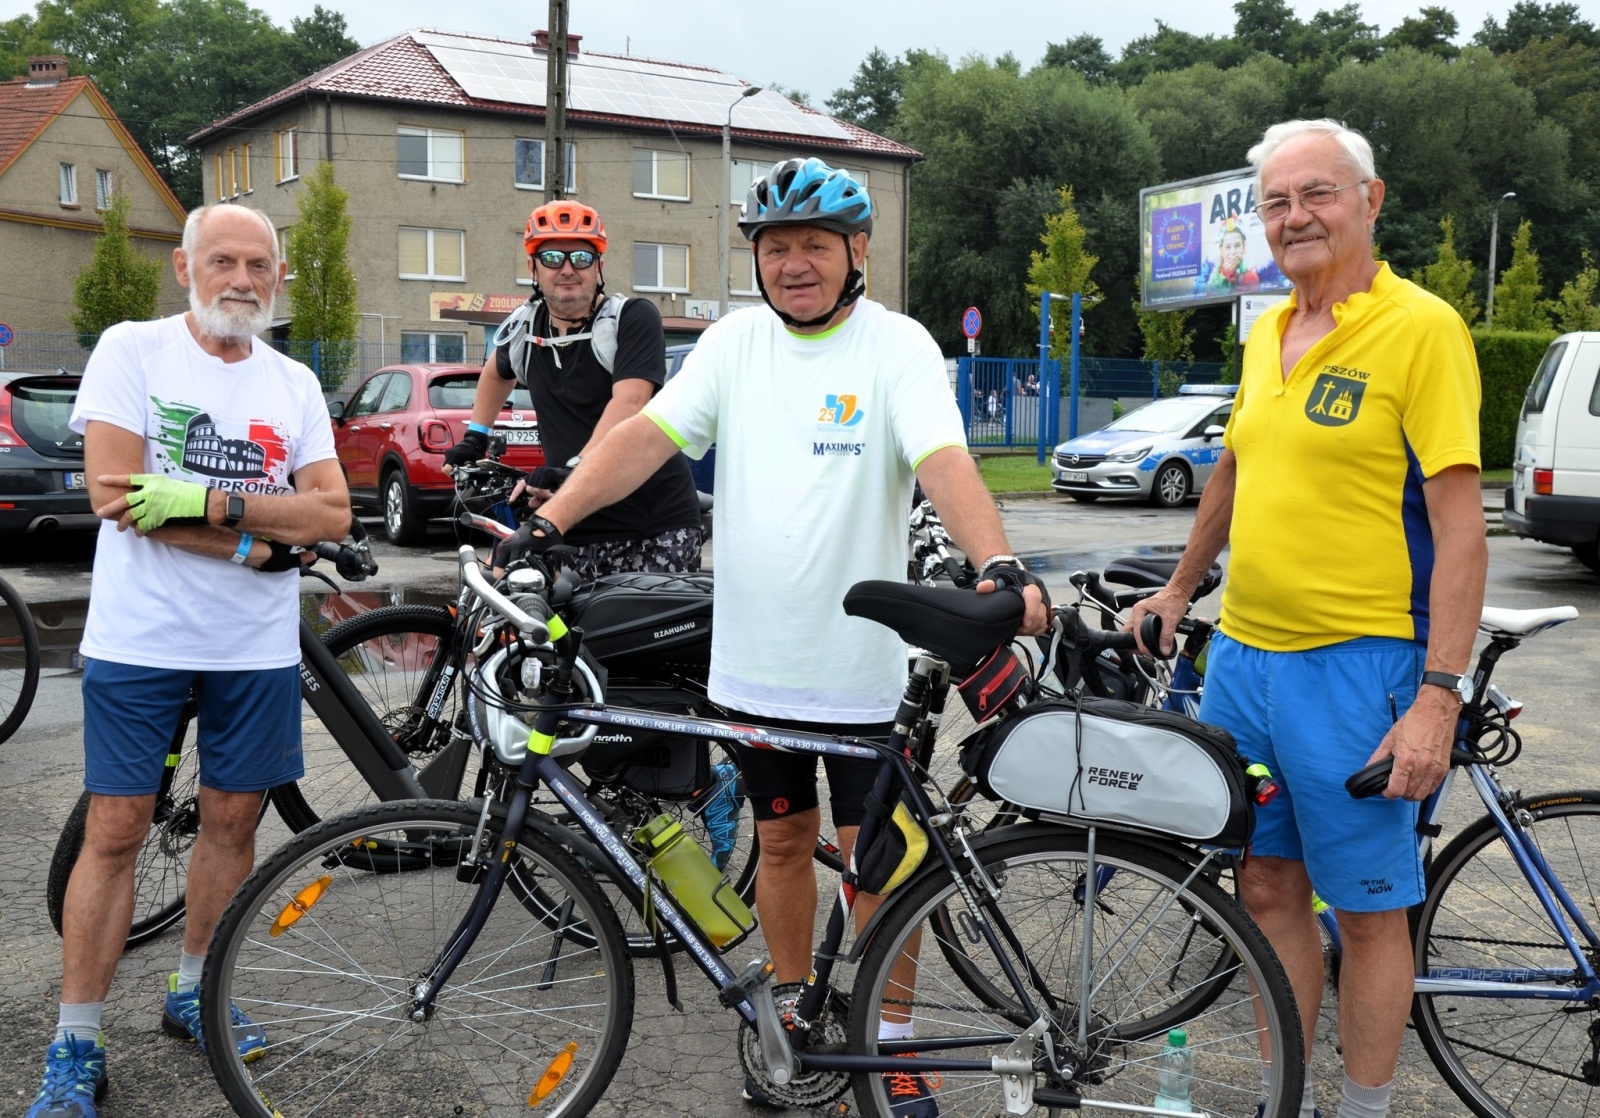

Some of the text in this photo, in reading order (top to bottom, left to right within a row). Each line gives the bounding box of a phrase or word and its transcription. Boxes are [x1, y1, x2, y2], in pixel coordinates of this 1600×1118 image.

[1209, 183, 1255, 225] ARA
[817, 407, 836, 422] 25
[653, 621, 696, 639] RZAHUAHU
[610, 714, 626, 724] FOR
[627, 717, 644, 726] YOU
[654, 721, 670, 730] FOR
[671, 723, 686, 732] LIFE
[696, 726, 712, 735] FOR
[713, 728, 744, 739] ENERGY
[750, 733, 763, 742] Tel.
[764, 736, 779, 744] +48
[780, 739, 794, 747] 501
[796, 741, 811, 749] 530
[812, 743, 827, 751] 765
[1087, 766, 1144, 782] RENEW
[1088, 776, 1139, 791] FORCE
[1529, 797, 1583, 809] GATORSKIN
[580, 810, 596, 826] FOR
[593, 824, 608, 839] YOU
[610, 843, 625, 860] FOR
[623, 855, 636, 874] LIFE
[682, 930, 694, 945] +48
[692, 941, 705, 957] 501
[702, 955, 715, 969] 530
[712, 967, 726, 981] 765
[950, 870, 986, 925] AUTHOR
[1367, 883, 1394, 896] NOW
